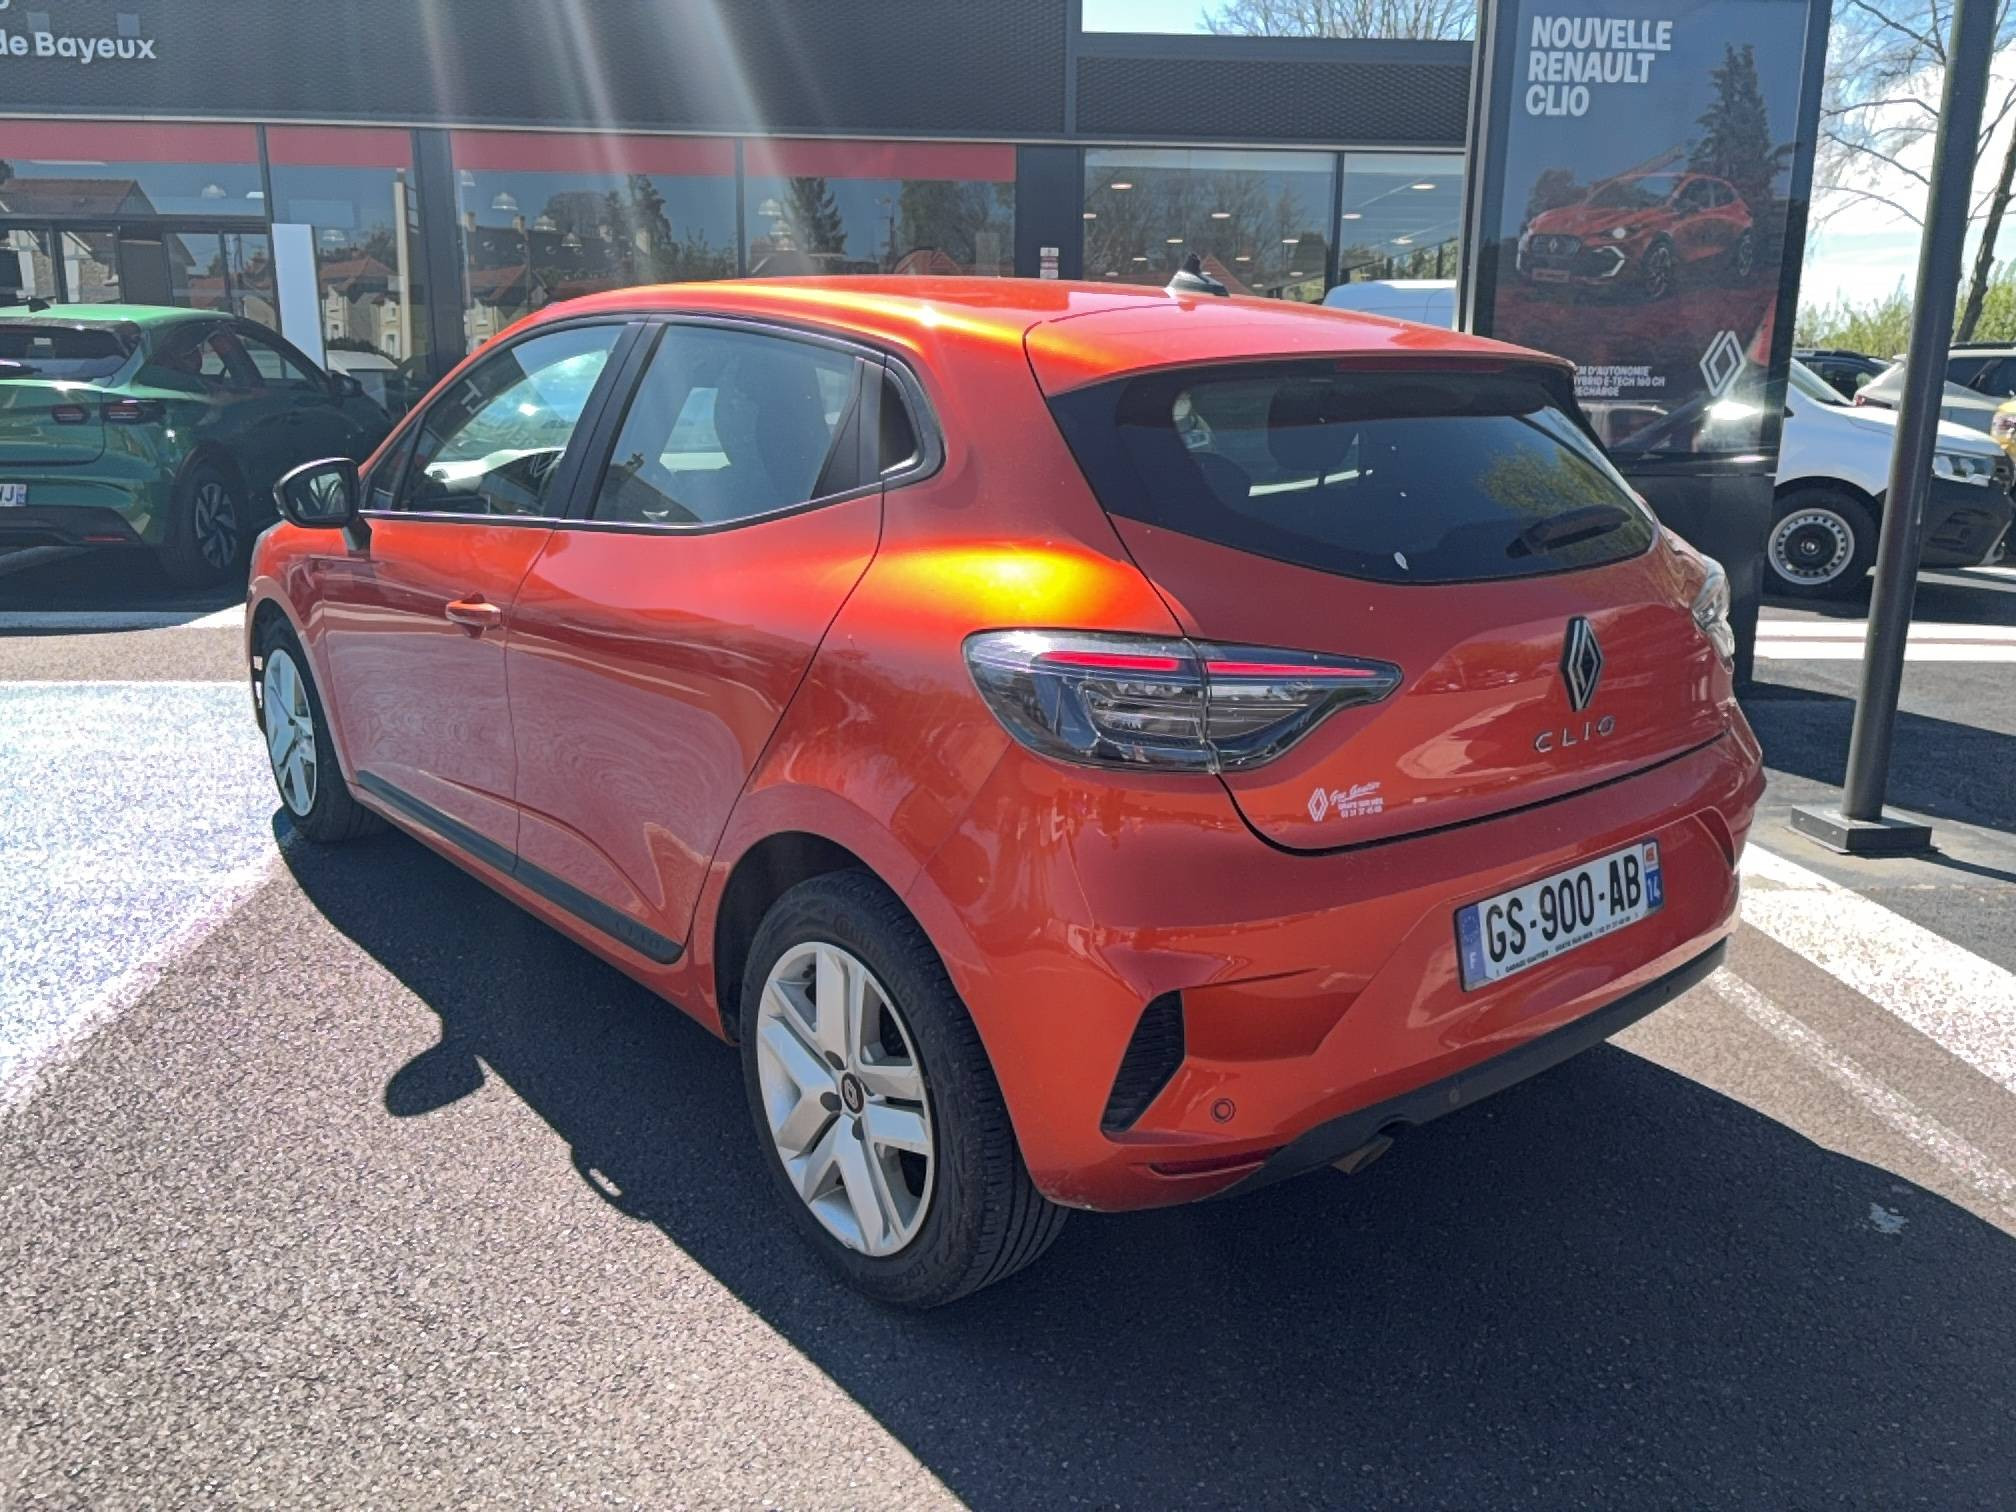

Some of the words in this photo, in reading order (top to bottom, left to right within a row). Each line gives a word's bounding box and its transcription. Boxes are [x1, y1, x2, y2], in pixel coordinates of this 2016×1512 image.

[35, 32, 157, 64] Bayeux
[1531, 16, 1672, 51] NOUVELLE
[1528, 51, 1655, 83] RENAULT
[1526, 84, 1589, 116] CLIO
[1535, 716, 1615, 753] CLIO
[1647, 875, 1661, 902] 14
[1486, 854, 1641, 963] GS-900-AB
[1470, 951, 1477, 969] F
